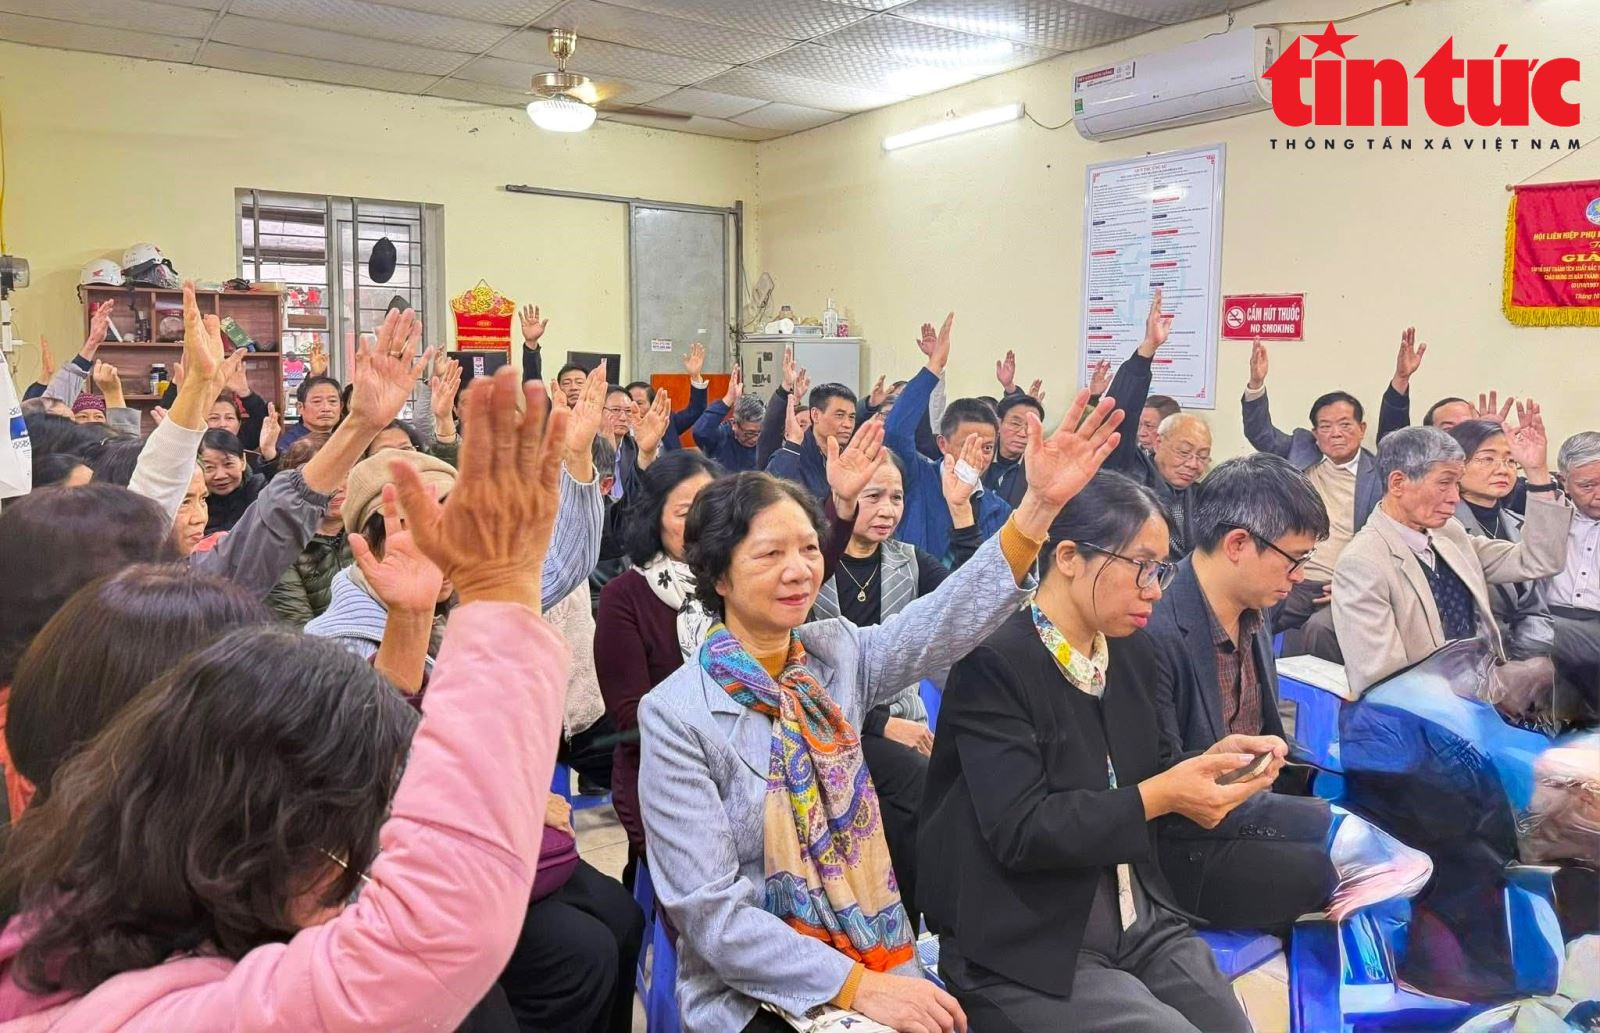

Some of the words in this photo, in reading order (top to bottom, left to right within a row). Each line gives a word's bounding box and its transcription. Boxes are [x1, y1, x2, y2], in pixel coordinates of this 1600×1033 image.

[1246, 303, 1262, 321] CẤM
[1263, 304, 1276, 321] HÚT
[1277, 301, 1300, 322] THUỐC
[1250, 323, 1261, 333] NO
[1261, 323, 1295, 334] SMOKING
